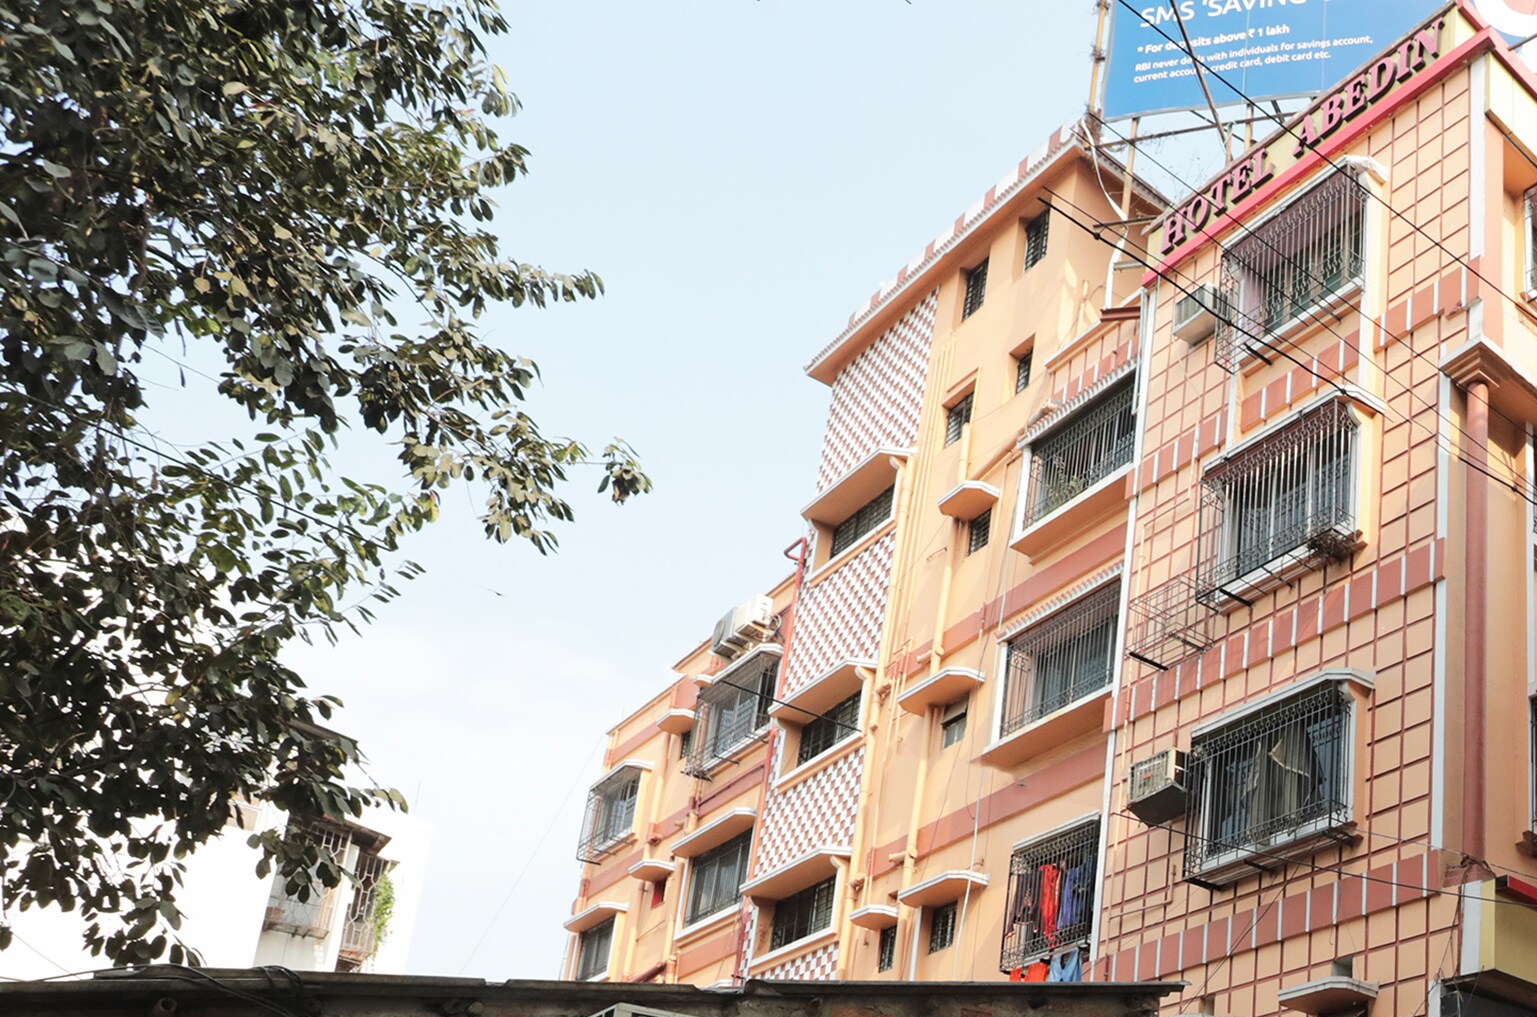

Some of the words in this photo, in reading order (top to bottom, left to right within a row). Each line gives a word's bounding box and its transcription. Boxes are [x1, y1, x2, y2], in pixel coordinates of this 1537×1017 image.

[1140, 1, 1195, 28] SMS
[1135, 61, 1151, 71] RBI
[1152, 59, 1179, 69] never
[1207, 51, 1228, 63] with
[1229, 43, 1279, 59] individuals
[1280, 42, 1295, 52] for
[1297, 39, 1331, 52] savings
[1332, 35, 1373, 47] account,
[1145, 43, 1163, 54] For
[1165, 36, 1211, 53] depsits
[1213, 31, 1246, 44] above
[1266, 24, 1290, 36] lakh
[1134, 71, 1168, 83] current
[1212, 62, 1238, 74] credit
[1264, 54, 1289, 65] debit
[1291, 53, 1312, 62] card
[1314, 50, 1331, 60] etc.
[1160, 147, 1276, 256] HOTEL
[1293, 16, 1447, 157] ABEDIN
